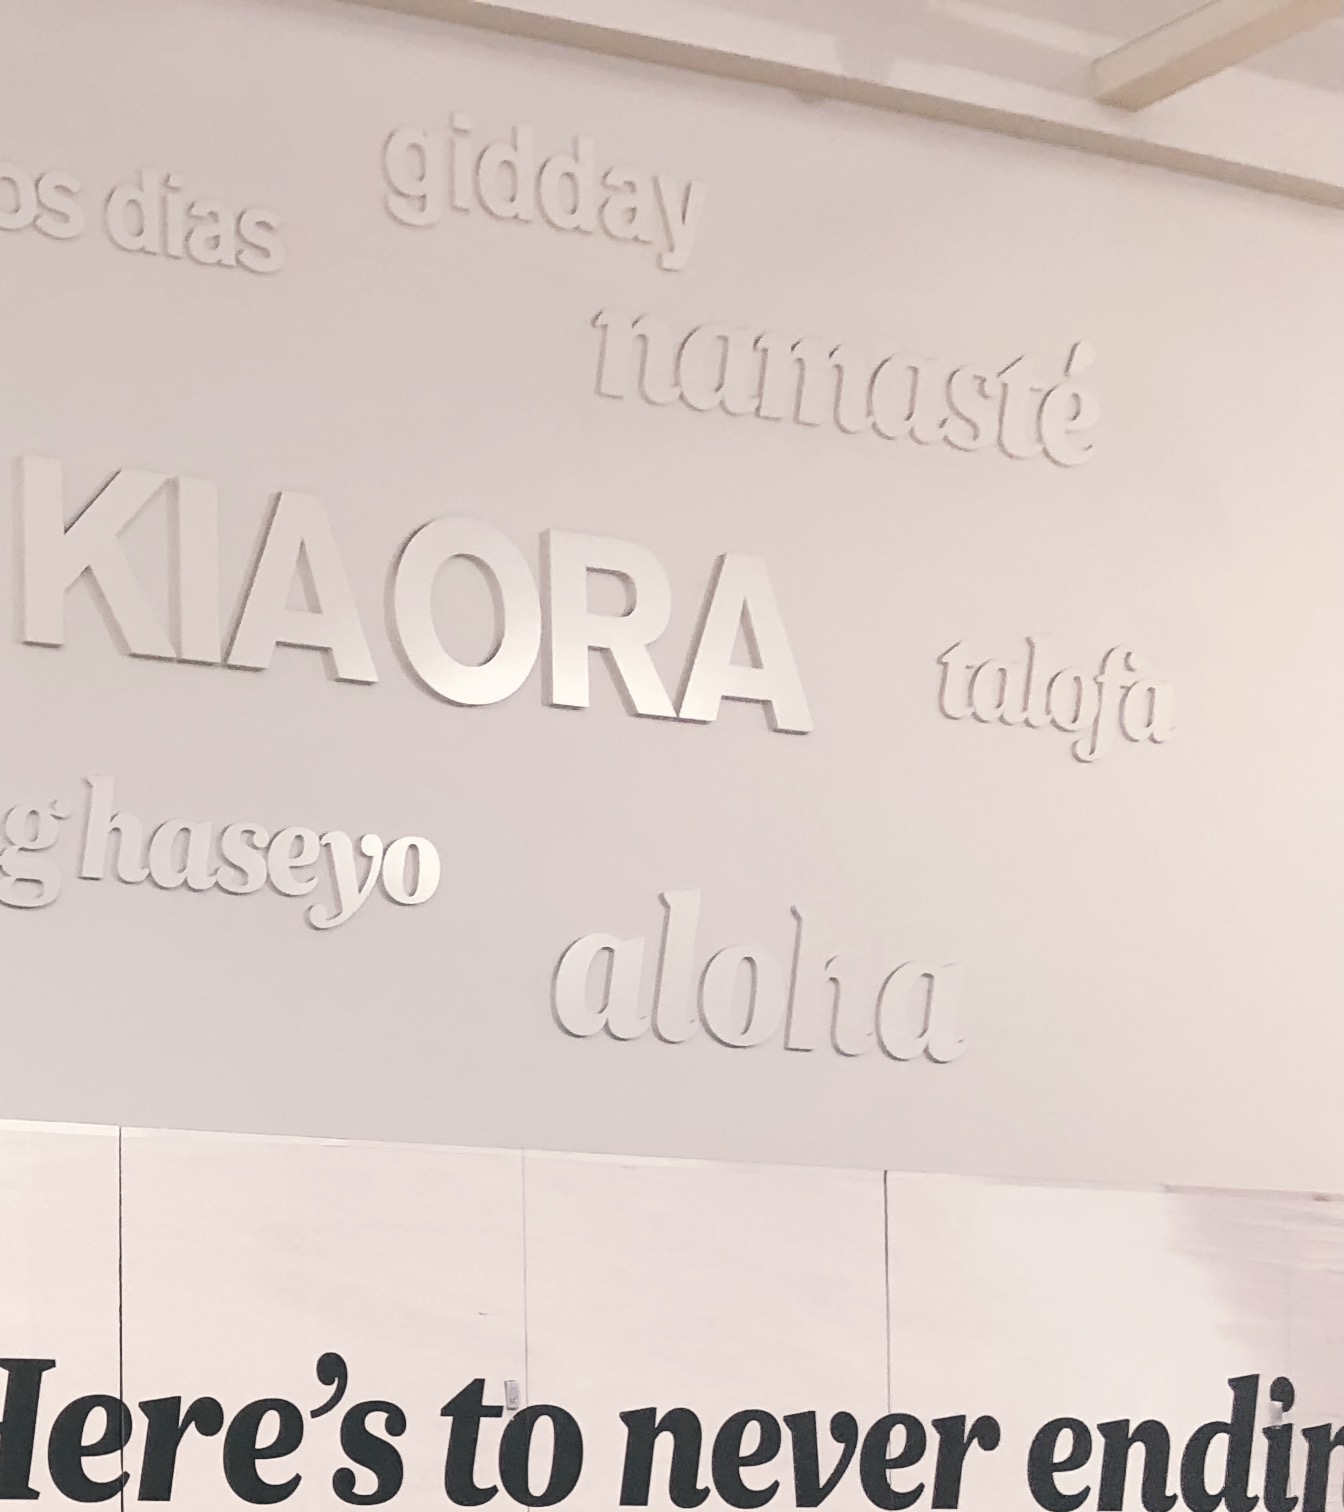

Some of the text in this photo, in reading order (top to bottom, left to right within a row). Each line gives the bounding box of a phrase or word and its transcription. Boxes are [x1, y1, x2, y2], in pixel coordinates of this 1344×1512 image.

[381, 111, 706, 272] gidday
[937, 634, 1178, 765] talofa
[550, 886, 969, 1065] aloha
[440, 1378, 584, 1508] to
[619, 1406, 1001, 1511] never
